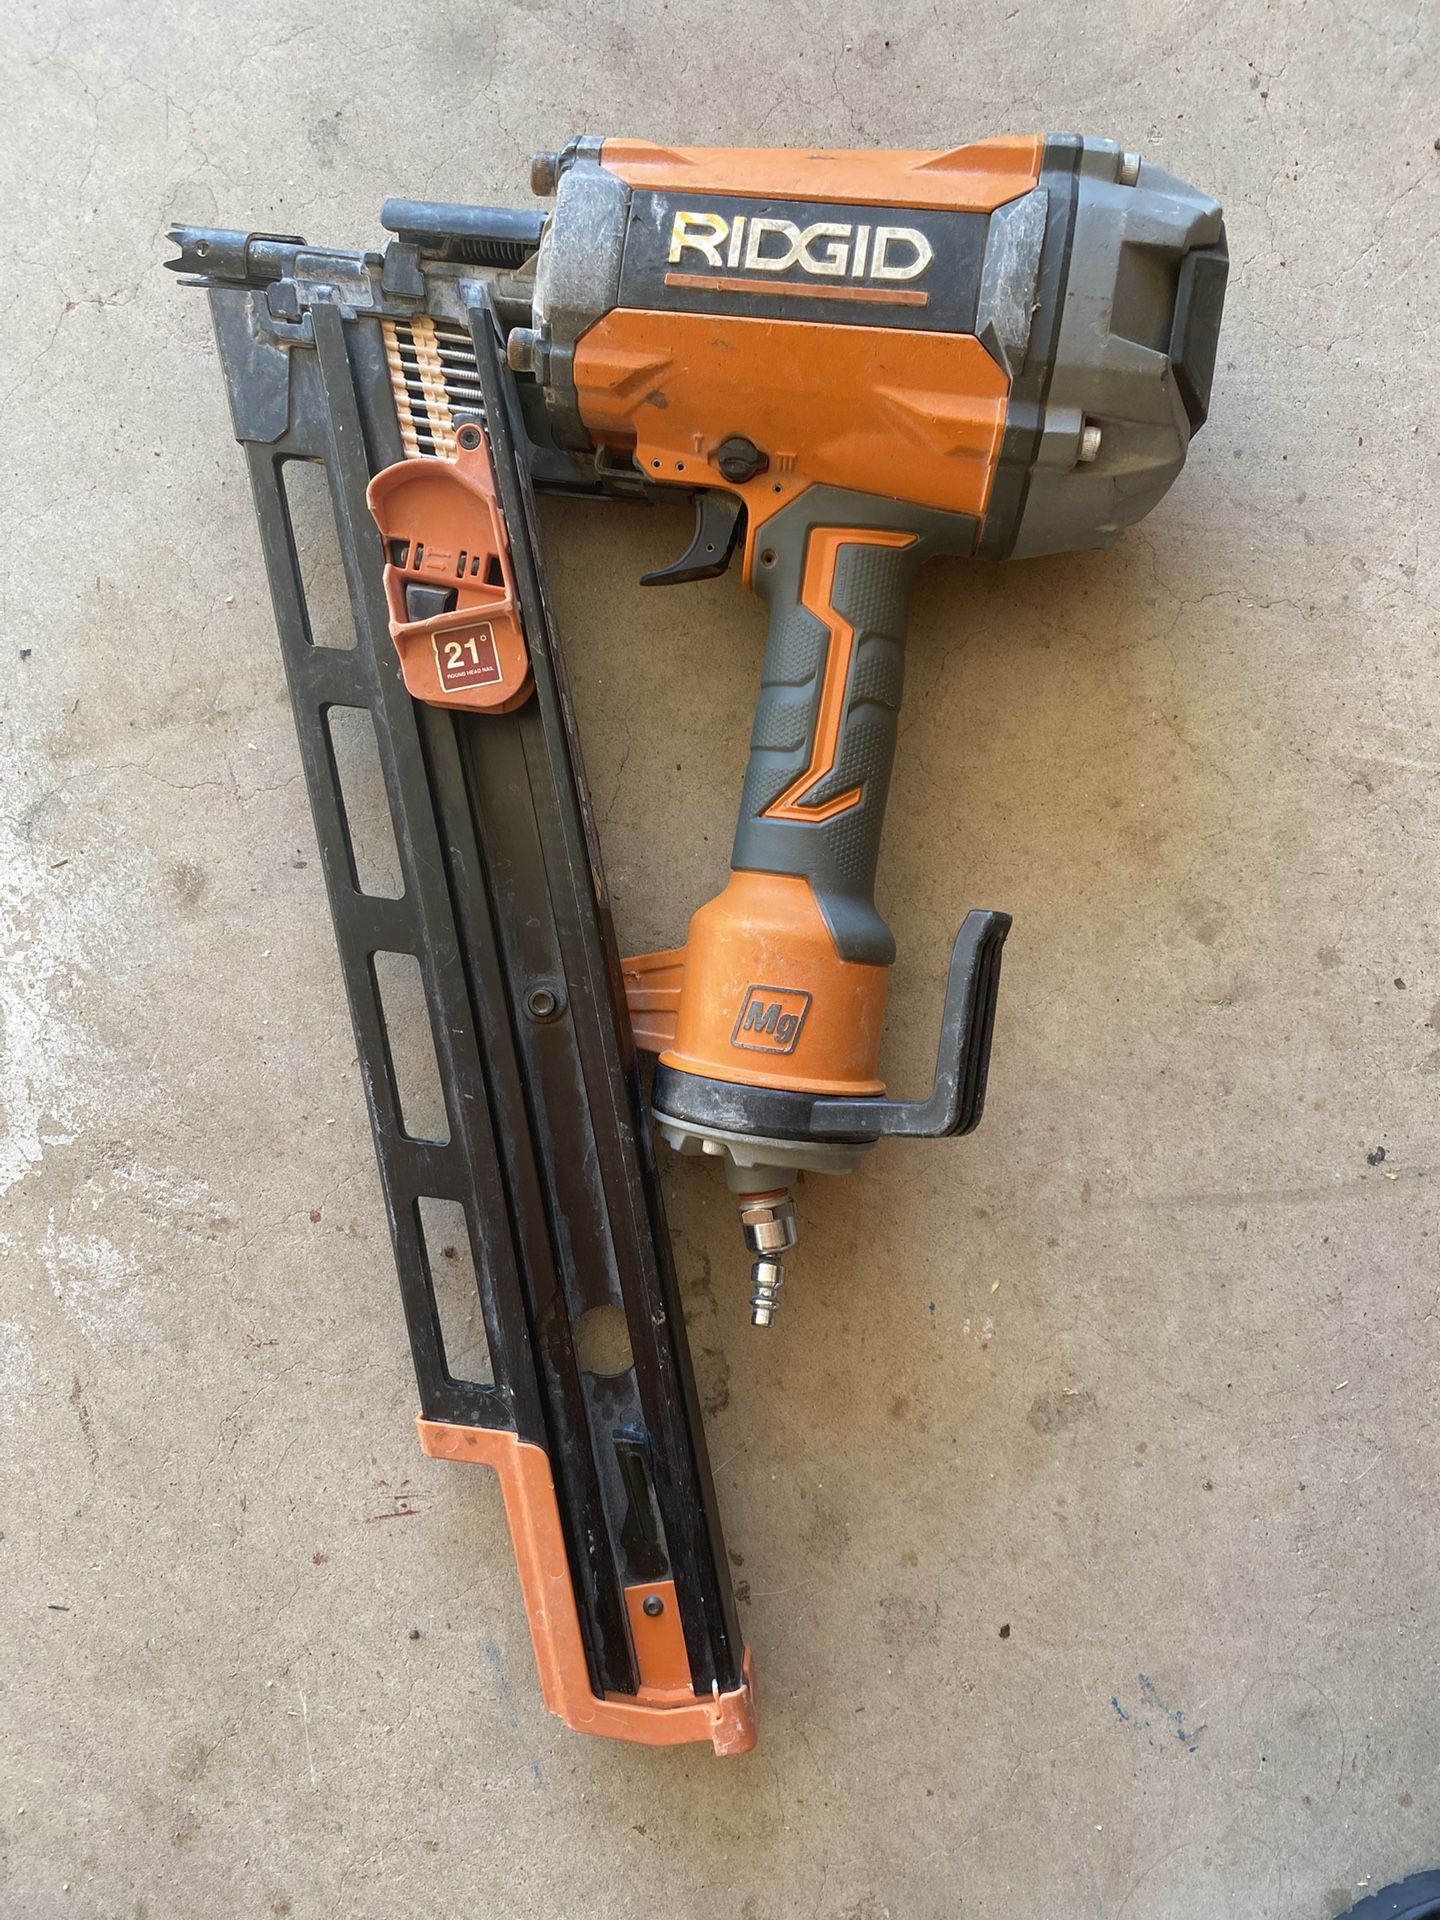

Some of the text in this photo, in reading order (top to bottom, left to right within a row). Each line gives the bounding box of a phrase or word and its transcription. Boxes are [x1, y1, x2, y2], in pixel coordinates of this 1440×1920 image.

[668, 211, 934, 280] RIDGID
[447, 671, 466, 679] ROUND
[743, 1000, 799, 1044] Mg
